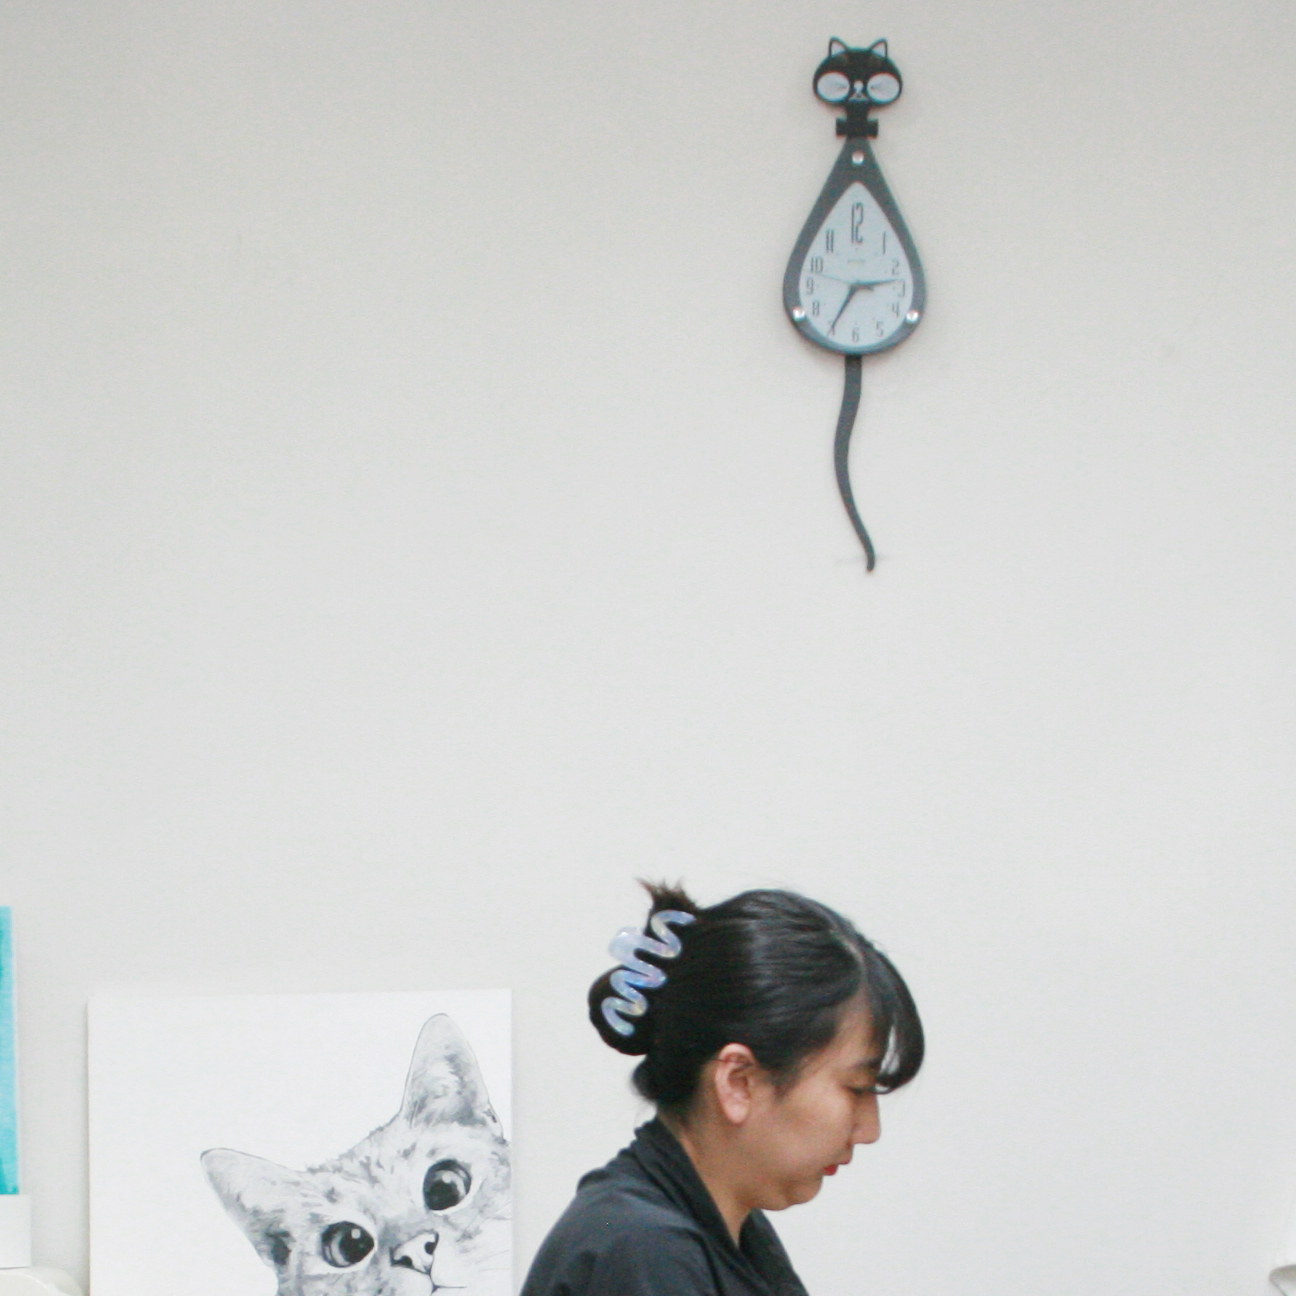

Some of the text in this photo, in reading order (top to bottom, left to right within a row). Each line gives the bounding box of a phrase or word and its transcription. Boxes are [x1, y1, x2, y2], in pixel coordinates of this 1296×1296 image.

[851, 202, 864, 245] 12
[826, 229, 835, 254] 11
[810, 256, 824, 274] 10
[891, 258, 900, 276] 2
[806, 276, 814, 295] 9
[812, 300, 820, 316] 8
[891, 301, 900, 319] 4
[851, 327, 860, 343] 6
[876, 320, 884, 338] 5
